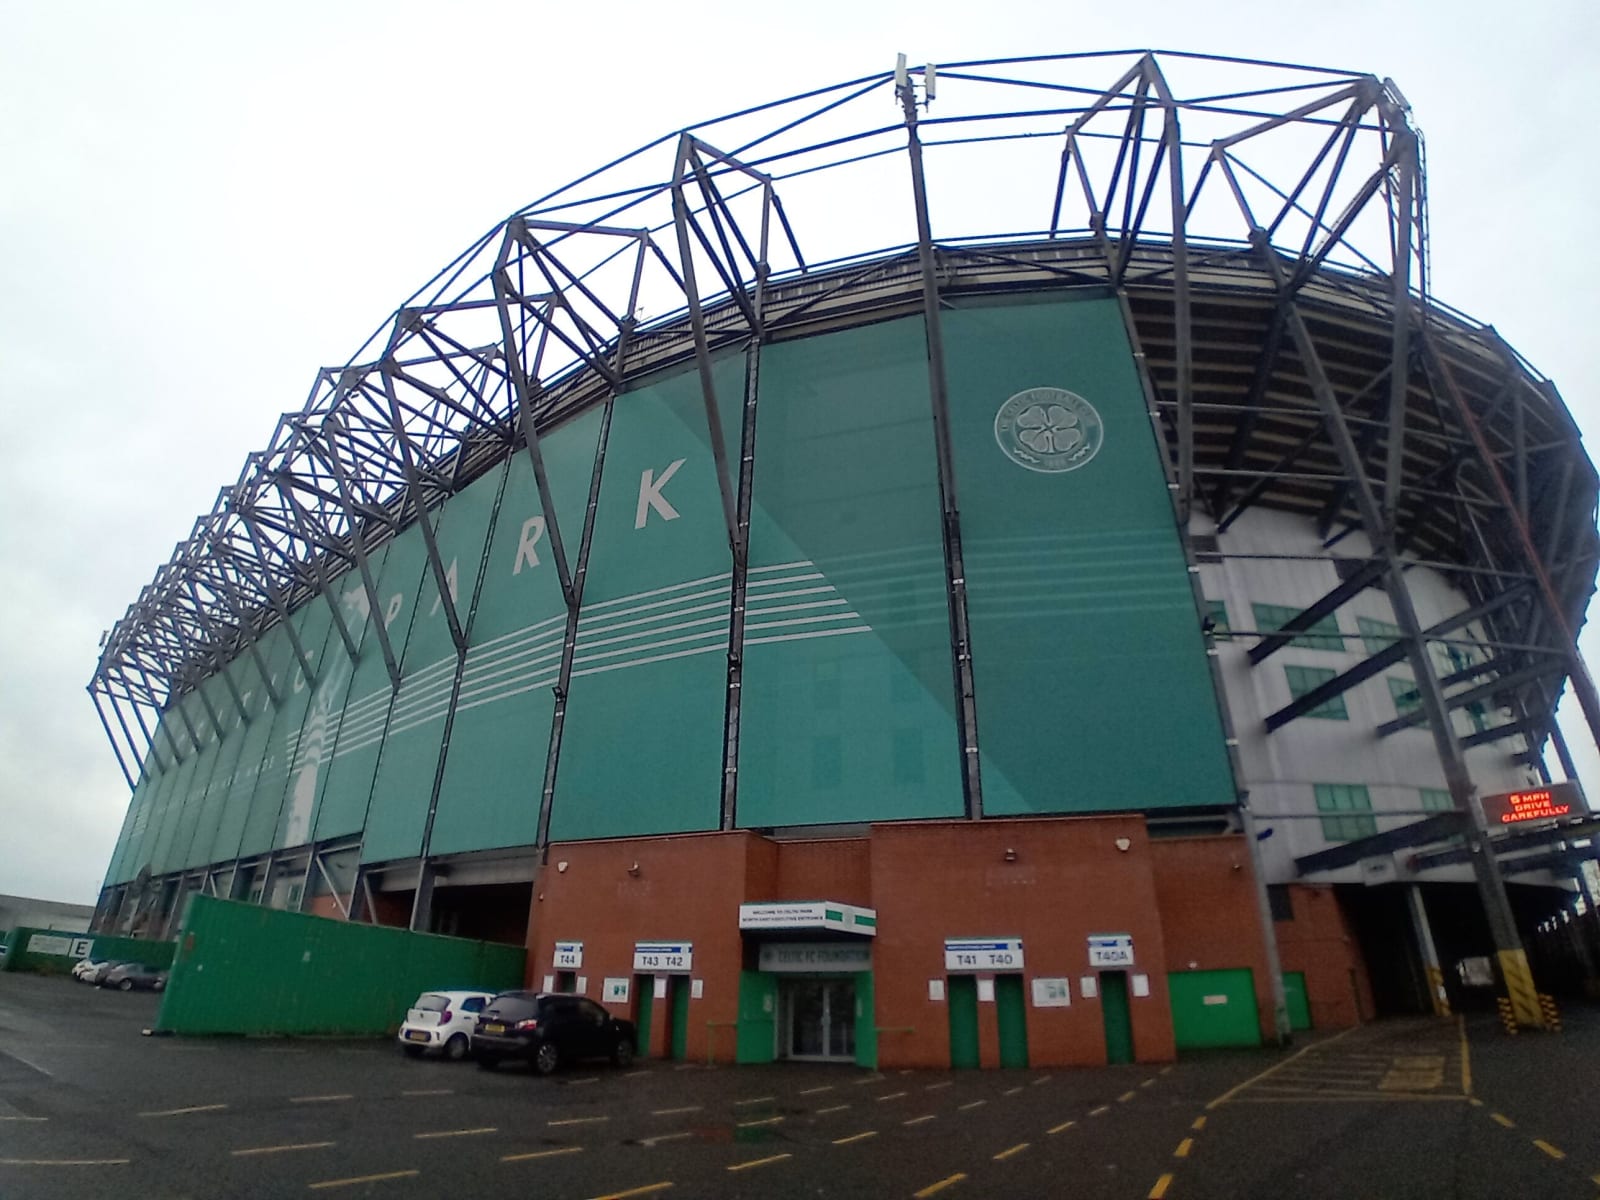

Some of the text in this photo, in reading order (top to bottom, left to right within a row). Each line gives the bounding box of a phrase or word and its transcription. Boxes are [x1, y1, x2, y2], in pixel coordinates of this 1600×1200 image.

[384, 458, 687, 630] PARK
[1522, 792, 1550, 803] MPH
[1514, 801, 1551, 812] DRIVE
[1502, 805, 1569, 822] CAREFULLY
[75, 941, 88, 955] E
[560, 955, 575, 964] T44
[642, 956, 683, 966] T43 T42
[956, 954, 1013, 965] T41 T40
